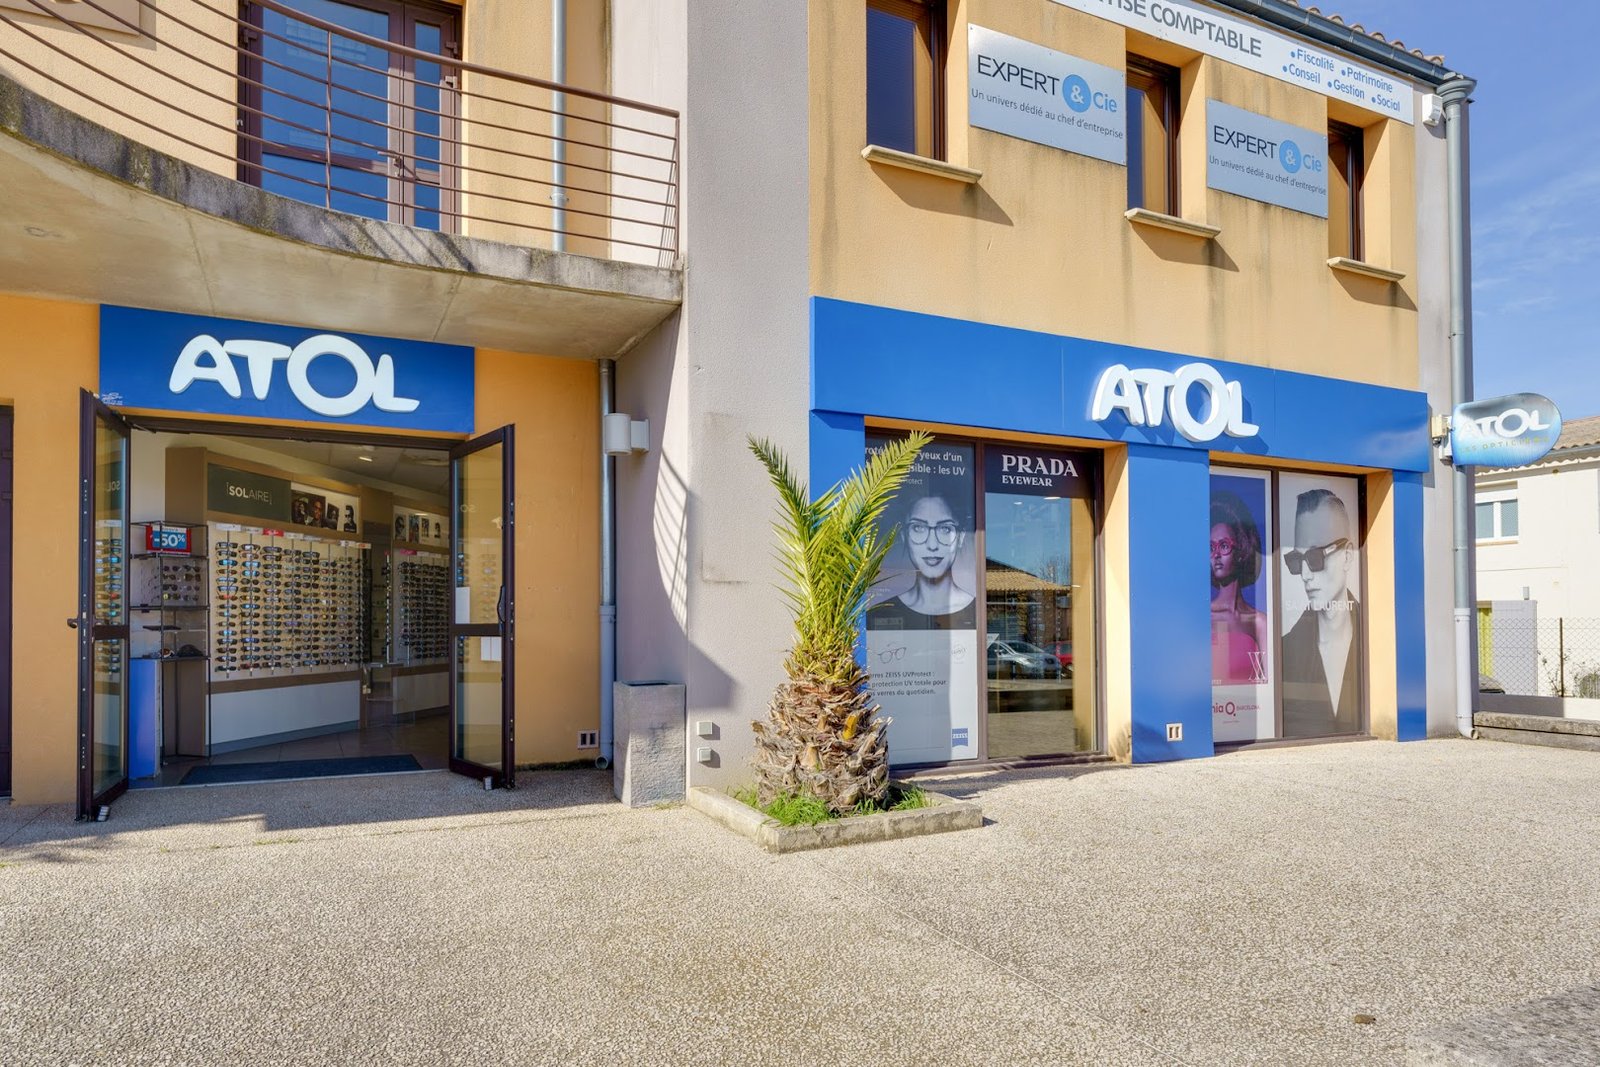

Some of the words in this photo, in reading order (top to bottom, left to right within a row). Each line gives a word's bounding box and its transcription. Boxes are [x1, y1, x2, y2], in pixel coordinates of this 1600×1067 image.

[1150, 3, 1262, 58] COMPTABLE
[977, 54, 1060, 96] EXPERT
[1070, 84, 1085, 104] &
[1092, 90, 1117, 113] Cie
[1288, 64, 1321, 84] Conseil
[1333, 80, 1365, 100] Gestion
[1377, 94, 1401, 112] Social
[1296, 48, 1335, 72] Fiscalité
[1347, 67, 1393, 93] Patrimoine
[971, 88, 984, 100] Un
[986, 94, 1018, 110] univers
[1020, 101, 1043, 117] dédié
[1045, 112, 1056, 121] au
[1058, 114, 1075, 126] chef
[1076, 118, 1124, 140] d'entreprise
[1214, 125, 1278, 159] EXPERT
[1285, 149, 1297, 166] &
[1302, 154, 1322, 172] Cie
[1209, 155, 1220, 164] Un
[1220, 159, 1245, 172] univers
[1246, 166, 1264, 178] dédié
[1265, 173, 1274, 181] au
[1274, 174, 1289, 185] chef
[168, 334, 421, 418] ATOL
[1091, 362, 1260, 442] ATOL
[1458, 408, 1551, 439] ATOL
[920, 452, 941, 461] yeux
[943, 452, 963, 462] d'un
[938, 465, 951, 475] les
[952, 466, 966, 476] UV
[1002, 454, 1078, 477] PRADA
[1002, 474, 1053, 487] EYEWEAR
[1313, 600, 1355, 612] LAURENT
[872, 680, 903, 688] protection
